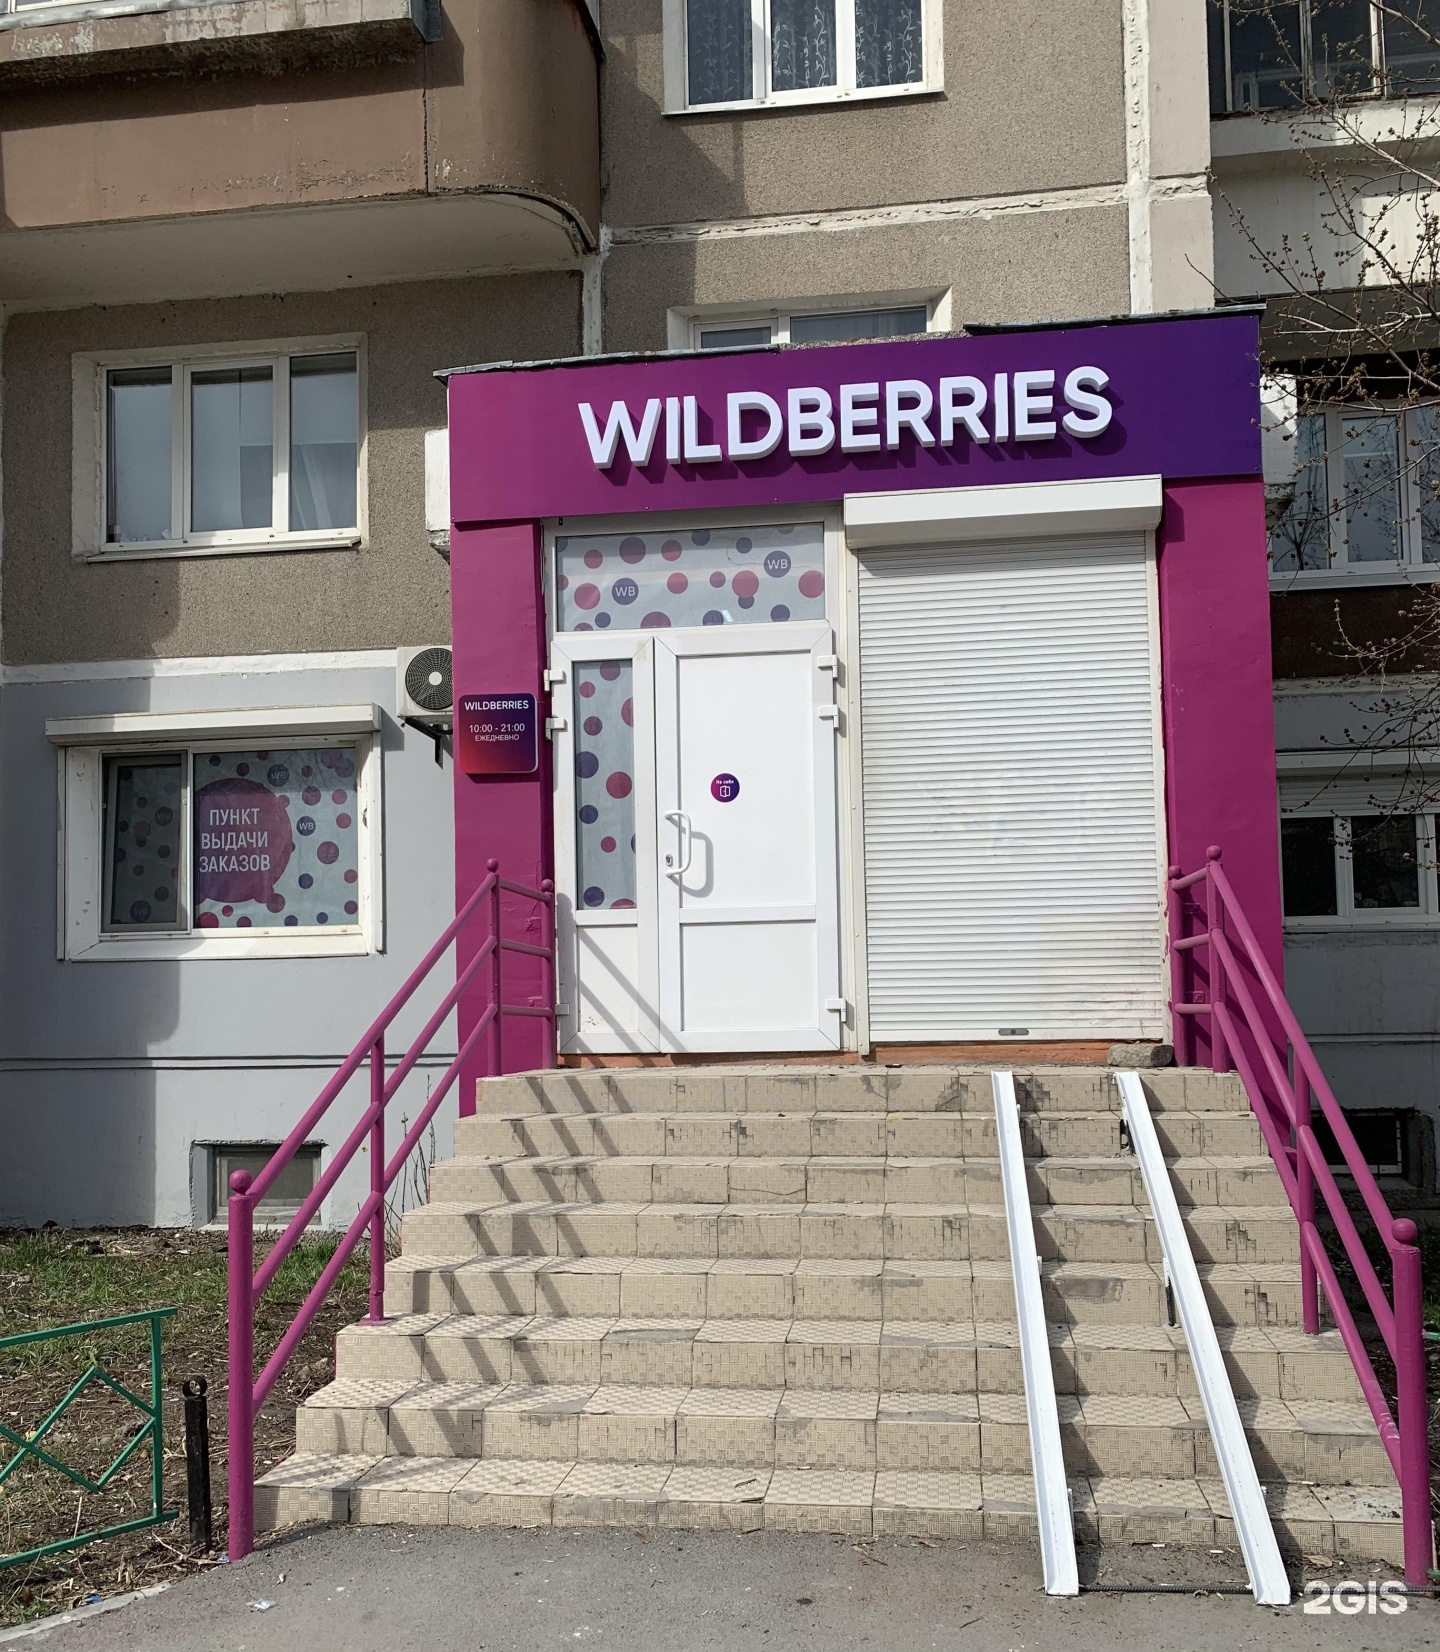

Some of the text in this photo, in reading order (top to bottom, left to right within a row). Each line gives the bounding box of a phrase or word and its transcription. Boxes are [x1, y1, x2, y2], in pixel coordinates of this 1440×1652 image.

[577, 366, 1113, 468] WILDBERRIES
[767, 558, 789, 570] WB
[614, 585, 636, 597] WB
[464, 700, 529, 711] WILDBERRIES
[469, 724, 493, 733] 10:00
[500, 723, 525, 732] 21:00
[474, 734, 520, 742] ЕЖЕДНЕВНО
[270, 771, 286, 780] WB
[209, 808, 260, 826] ПУНКТ
[298, 822, 314, 831] WB
[201, 831, 268, 851] ВЫДАЧИ
[199, 854, 271, 873] ЗАКАЗОВ
